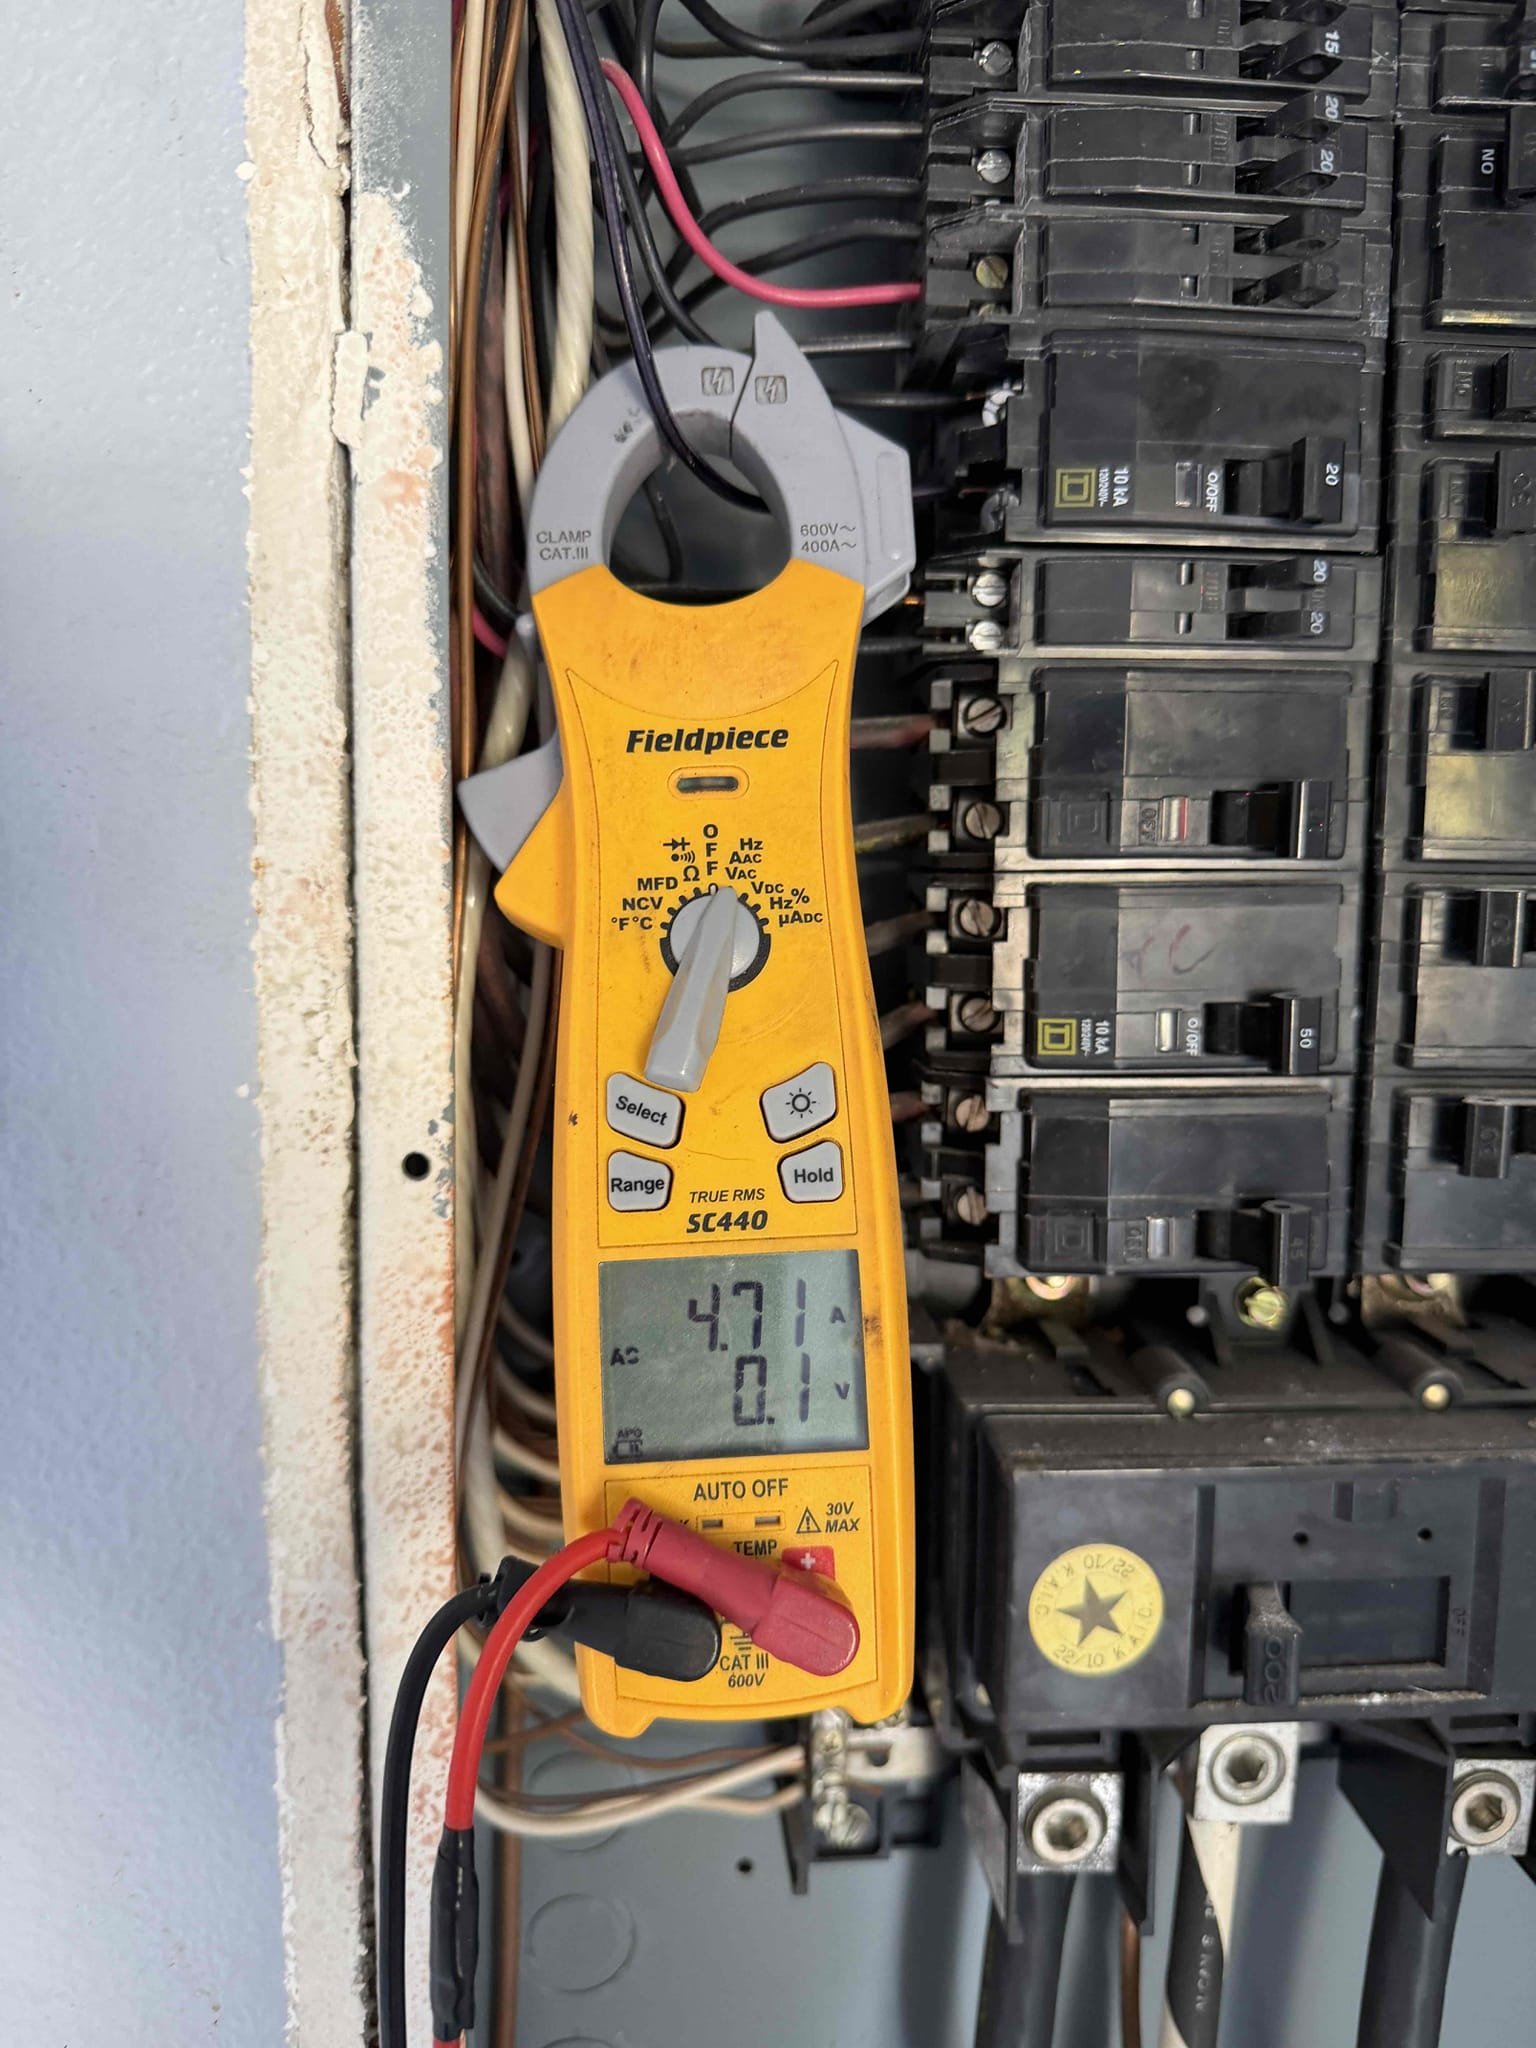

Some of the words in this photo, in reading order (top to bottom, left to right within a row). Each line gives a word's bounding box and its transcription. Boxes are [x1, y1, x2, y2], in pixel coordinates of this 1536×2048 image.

[1325, 29, 1340, 54] 15
[1325, 95, 1339, 119] 20
[1320, 149, 1334, 172] 20
[1480, 148, 1495, 175] ON
[1113, 465, 1129, 485] 10
[1326, 462, 1340, 486] 20
[1112, 487, 1129, 507] kA
[536, 530, 592, 544] CLAMP
[1312, 559, 1327, 583] 20
[1310, 611, 1324, 635] 20
[626, 727, 789, 755] Fieldpiece
[740, 838, 763, 851] Hz
[729, 851, 762, 865] AAC
[725, 866, 757, 881] VAC
[637, 877, 678, 891] MFD
[751, 881, 784, 896] VDC
[622, 897, 664, 911] NCV
[1095, 1020, 1109, 1034] 10
[1095, 1036, 1109, 1055] kA
[1300, 1027, 1313, 1048] 50
[615, 1095, 668, 1126] Select
[794, 1168, 834, 1184] Hold
[611, 1177, 665, 1195] Range
[689, 1189, 729, 1203] TRUE
[732, 1188, 765, 1201] RMS
[686, 1210, 768, 1233] SC440
[688, 1278, 807, 1351] 4.71
[830, 1306, 846, 1324] A
[610, 1347, 640, 1366] AC
[733, 1352, 810, 1427] 0.1
[834, 1382, 850, 1400] V
[693, 1480, 746, 1501] AUTO
[752, 1478, 789, 1497] OFF
[826, 1502, 854, 1516] 30V
[825, 1518, 860, 1533] MAX
[733, 1539, 777, 1556] TEMP
[720, 1654, 751, 1671] CAT
[756, 1652, 769, 1670] III
[1264, 1635, 1282, 1701] 200
[728, 1672, 765, 1689] 600V
